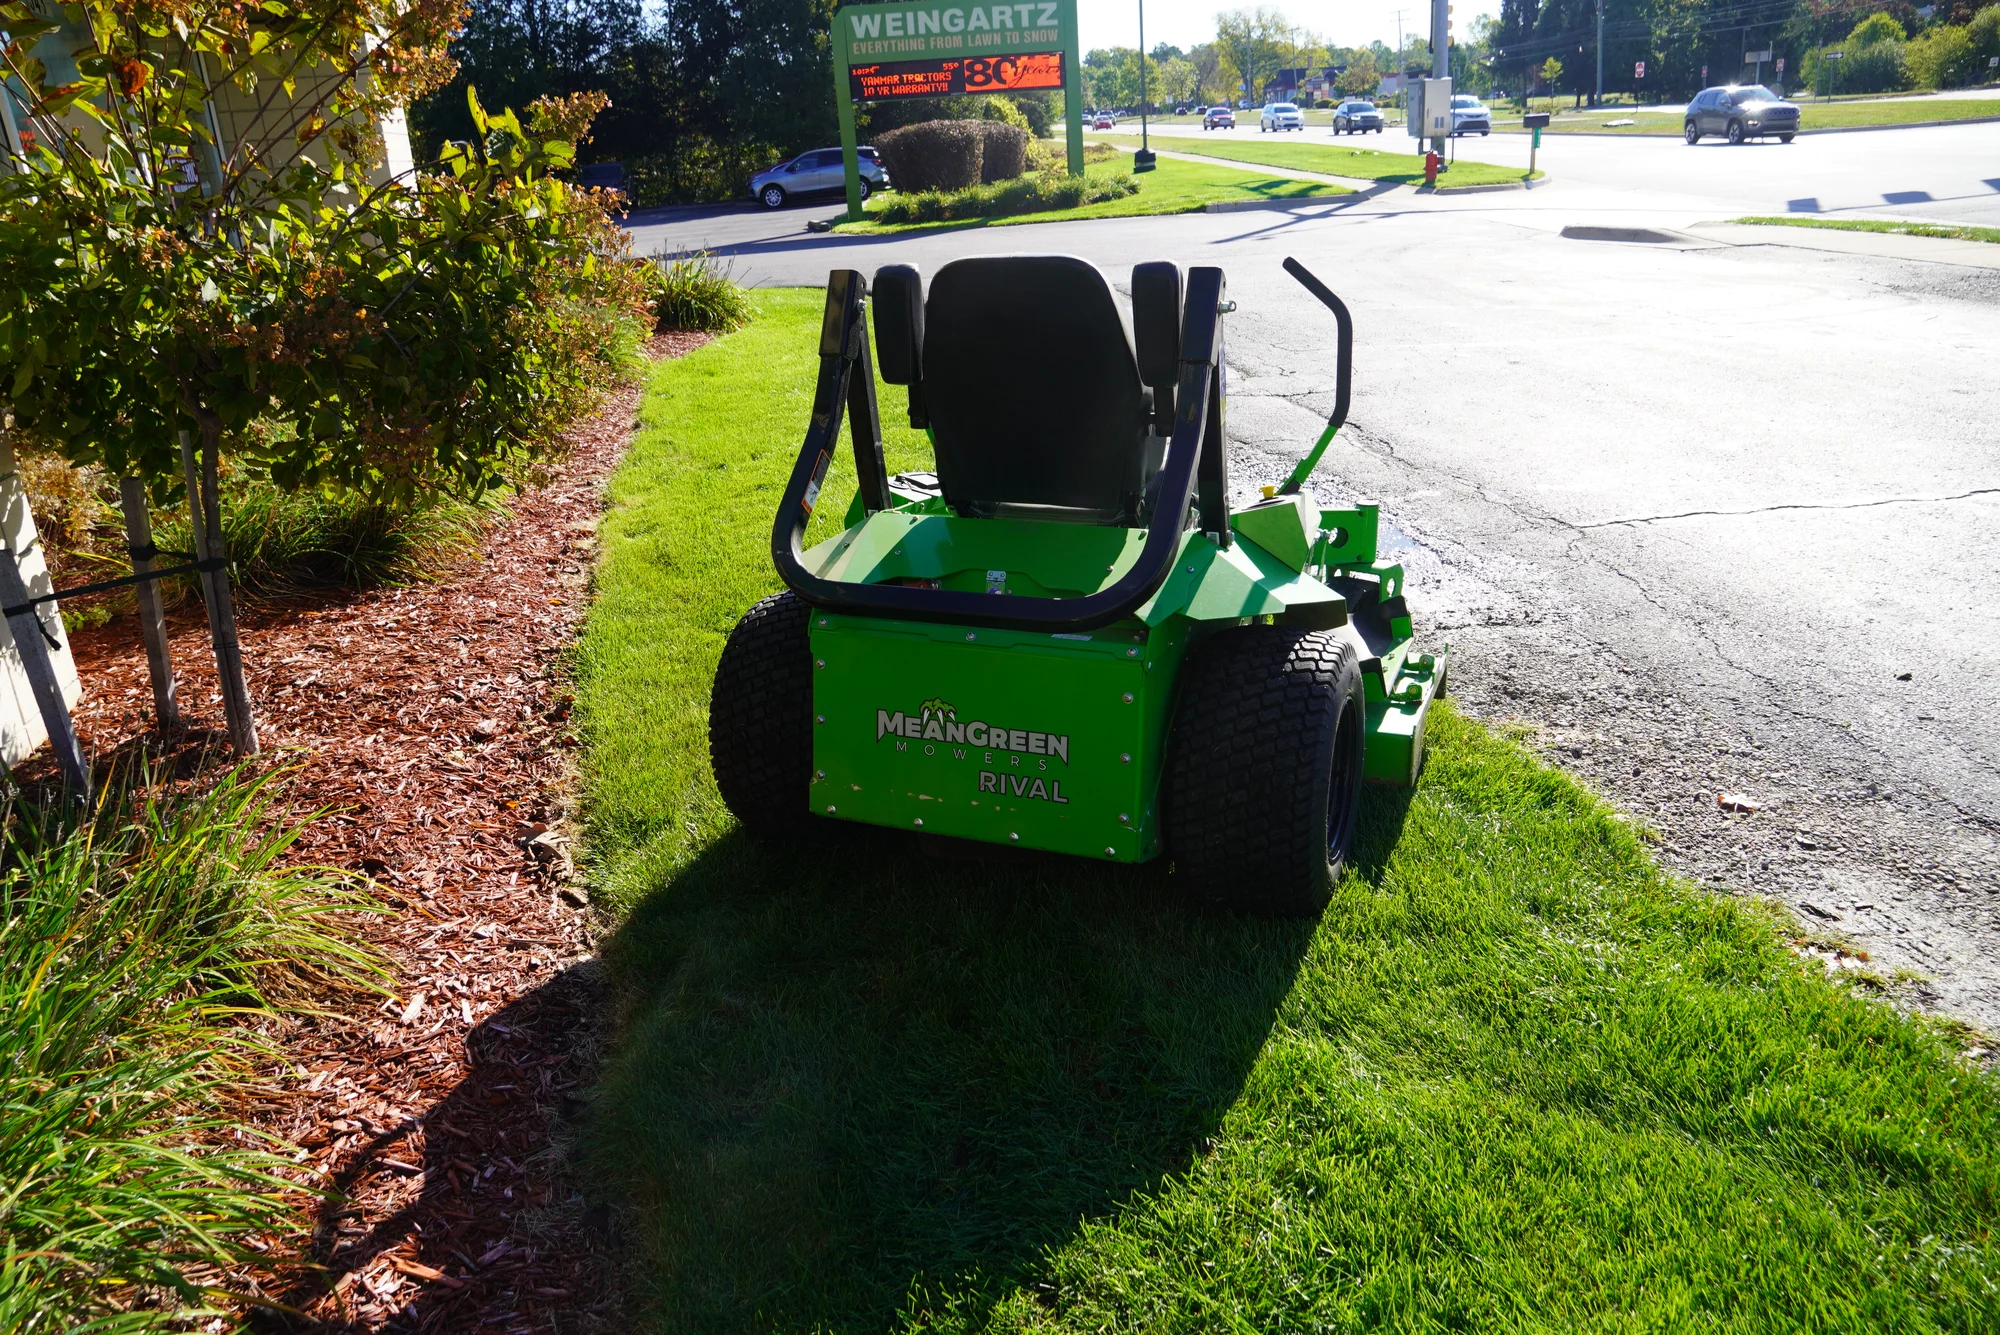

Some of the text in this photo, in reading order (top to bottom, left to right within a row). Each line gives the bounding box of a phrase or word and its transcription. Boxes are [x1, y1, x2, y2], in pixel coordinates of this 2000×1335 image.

[851, 2, 1058, 39] WEINGARTZ
[853, 29, 1058, 55] EVERYTHING FROM LAWN TO SNOW
[861, 72, 952, 87] YANMAR TRACTORS
[864, 82, 949, 97] 10 YR WARRANTY!!
[877, 708, 1069, 767] MEANGREEN
[979, 770, 1070, 804] RIVAL
